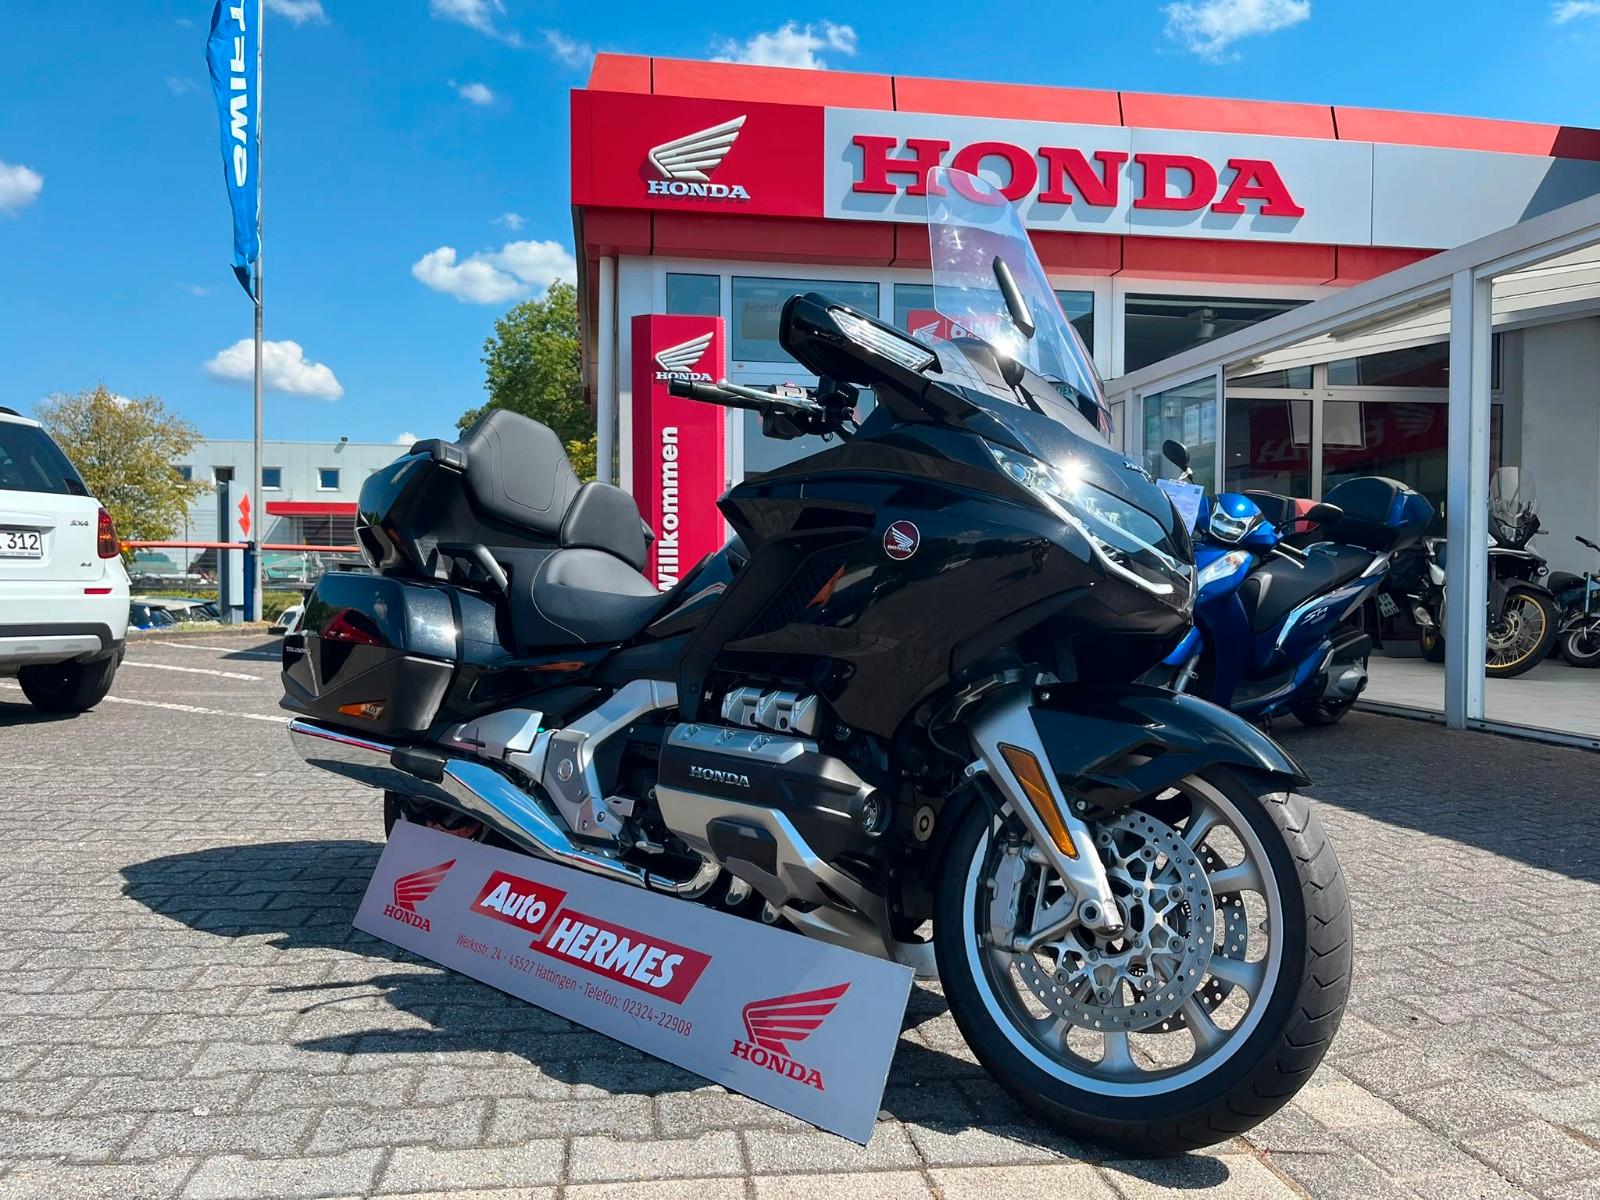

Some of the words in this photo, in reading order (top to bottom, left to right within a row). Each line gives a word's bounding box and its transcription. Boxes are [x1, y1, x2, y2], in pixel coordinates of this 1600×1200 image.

[647, 180, 751, 200] HONDA
[852, 135, 1305, 218] HONDA
[655, 371, 713, 382] HONDA
[658, 426, 679, 594] Willkommen
[7, 533, 39, 550] 312
[689, 766, 750, 788] HONDA
[383, 904, 432, 932] HONDA
[480, 881, 547, 924] Auto
[547, 917, 684, 989] HERMES
[456, 932, 489, 957] Werksstr.
[490, 946, 501, 961] 24
[509, 954, 535, 974] 45527
[535, 963, 577, 992] Hattingen
[584, 982, 620, 1009] Telefon:
[622, 998, 693, 1037] 02324-22908
[730, 1040, 825, 1092] HONDA
